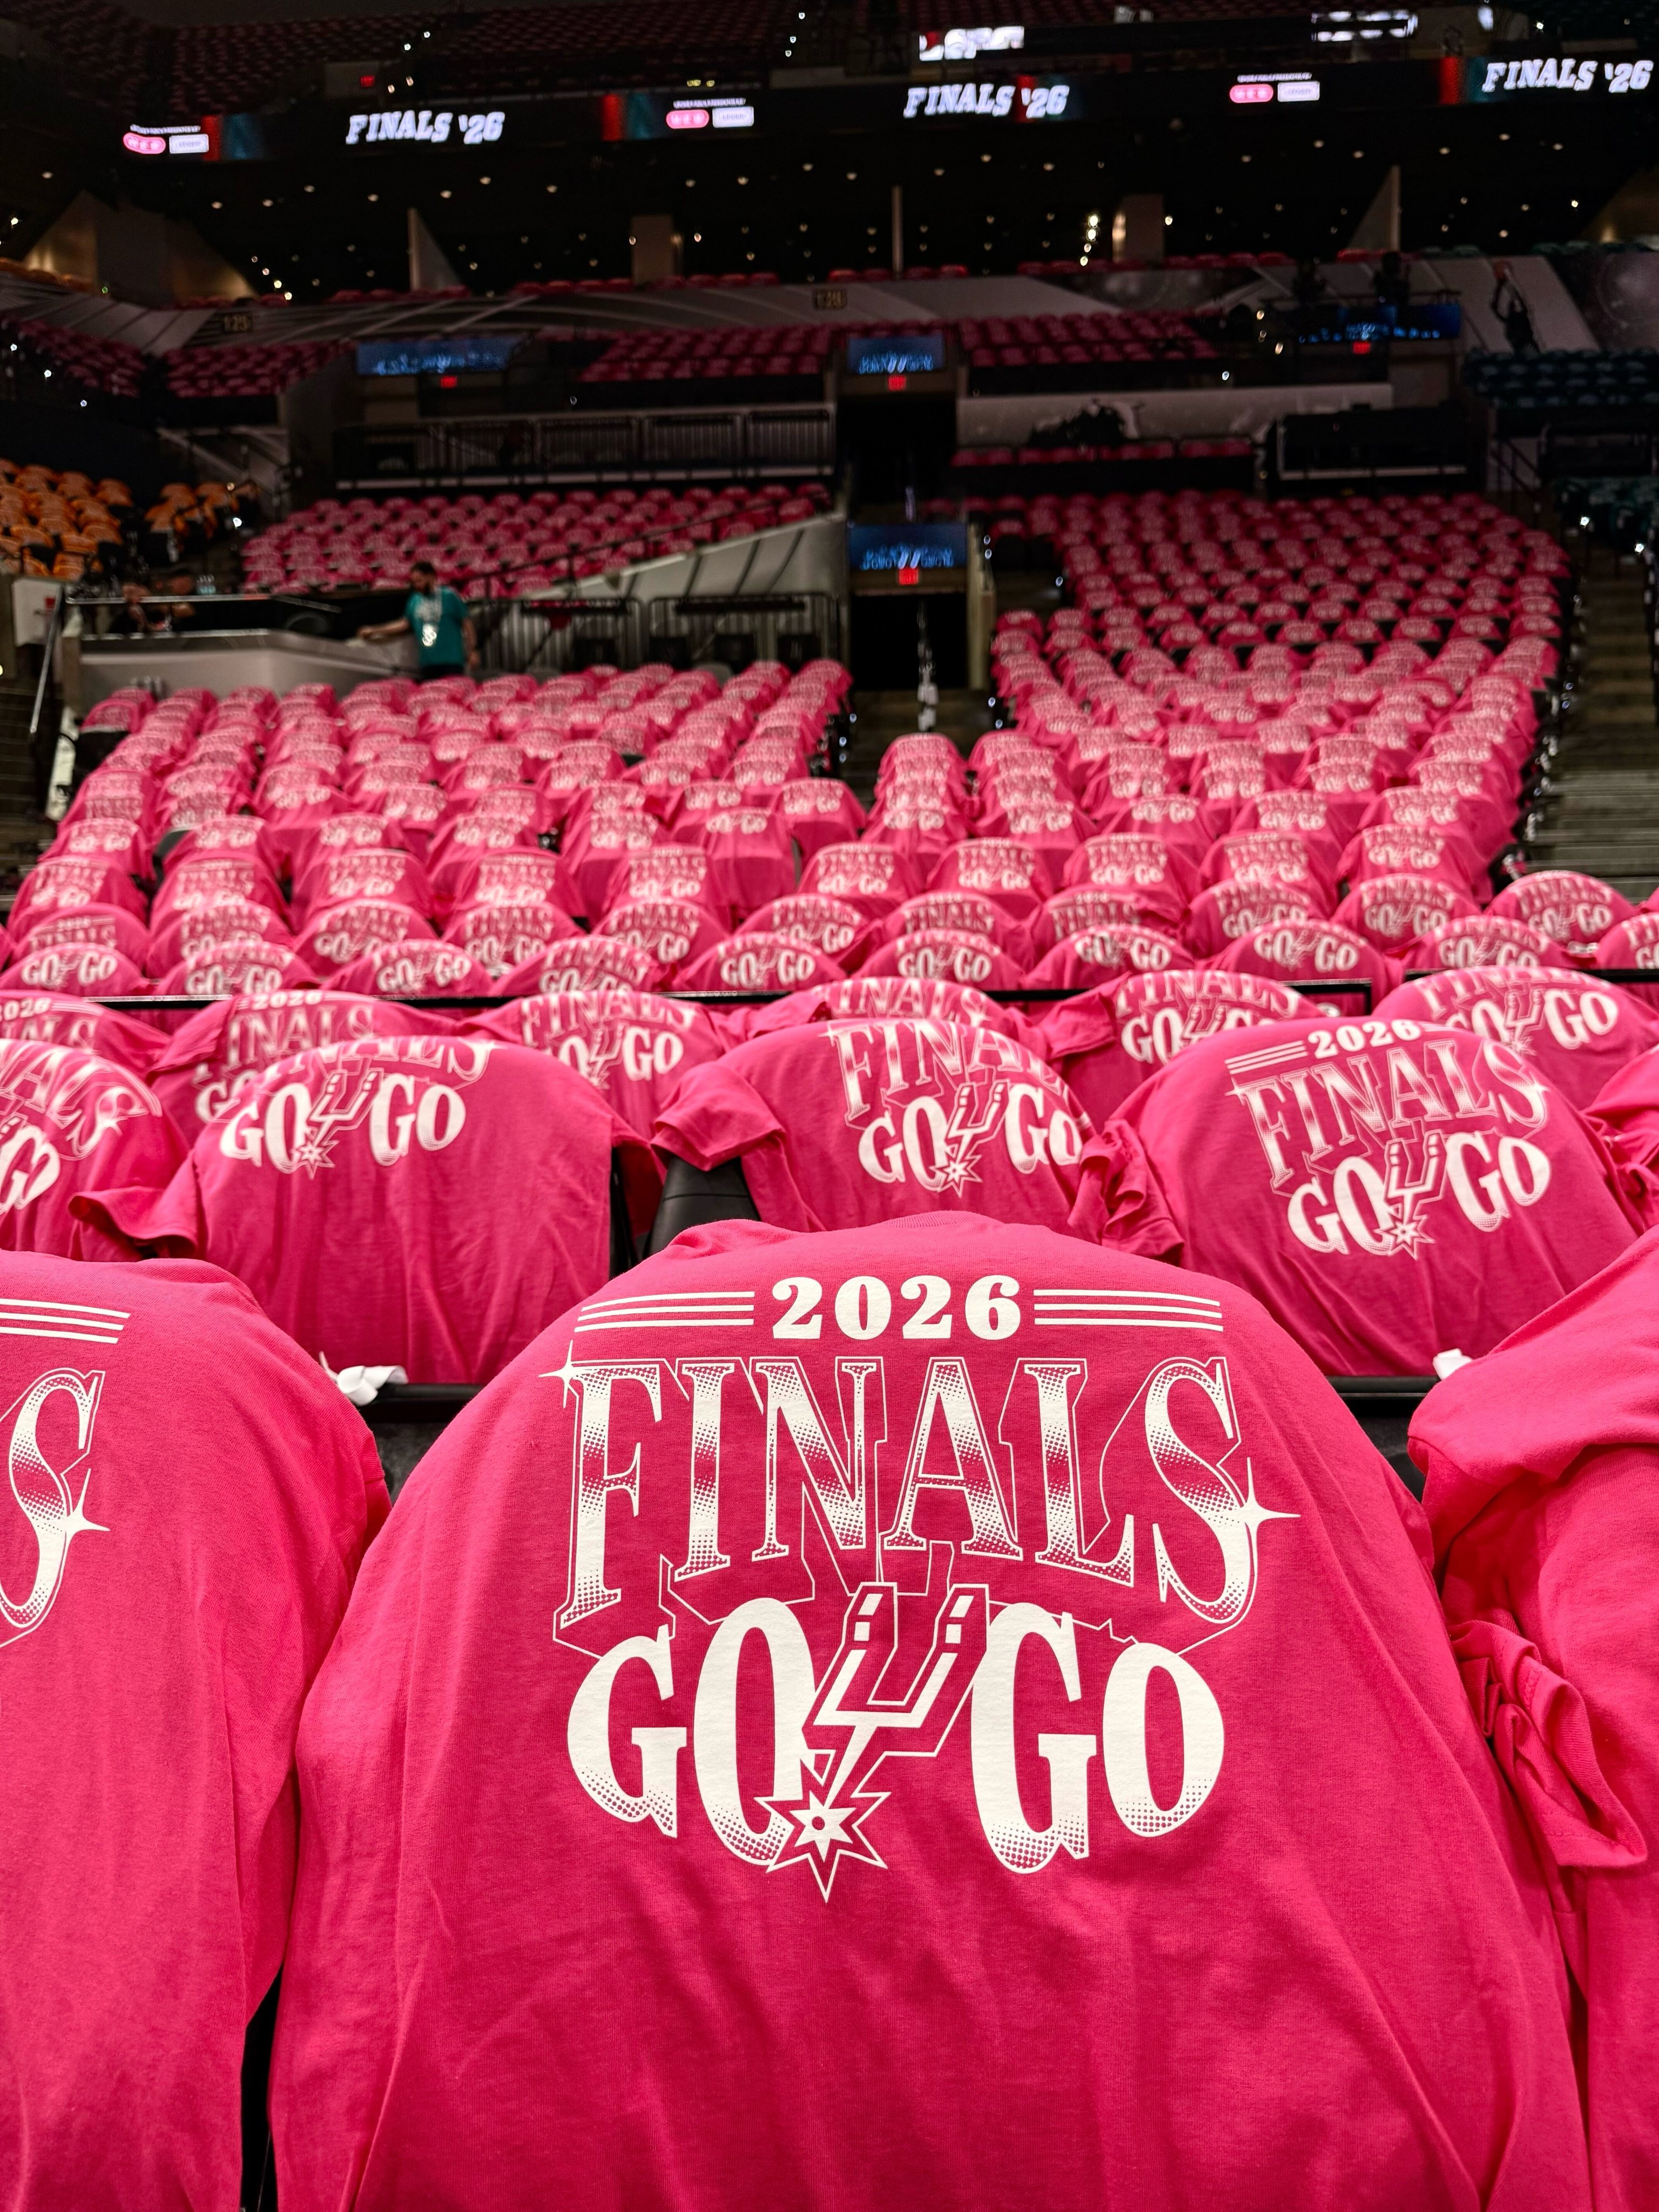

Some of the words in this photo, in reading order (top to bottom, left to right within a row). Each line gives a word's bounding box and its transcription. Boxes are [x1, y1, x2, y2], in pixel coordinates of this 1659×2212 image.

[1482, 58, 1597, 92] FINALS
[1604, 60, 1654, 93] '26
[903, 84, 1015, 118] FINALS
[1022, 85, 1070, 118] '26
[346, 111, 453, 144] FINALS
[459, 111, 505, 144] '26
[22, 951, 60, 990] GO
[76, 950, 117, 985] GO
[377, 957, 416, 993] GO
[433, 952, 472, 988] GO
[720, 952, 760, 989] GO
[777, 950, 816, 986] GO
[898, 947, 935, 982] GO
[953, 946, 992, 983] GO
[1254, 929, 1297, 966] GO
[1314, 936, 1359, 973] GO
[0, 997, 52, 1022] 026
[1543, 988, 1618, 1050] GO
[622, 1026, 683, 1081] GO
[1121, 1007, 1185, 1066] GO
[1308, 1020, 1423, 1059] 2026
[220, 1082, 312, 1174] GO
[369, 1073, 467, 1167] GO
[858, 1096, 948, 1192] GO
[1004, 1083, 1082, 1174] GO
[1240, 1038, 1550, 1191] FINALS
[1287, 1155, 1393, 1256] GO
[1445, 1131, 1551, 1232] GO
[772, 1275, 1022, 1340] 2026
[555, 1356, 1258, 1626] FINALS
[567, 1597, 817, 1865] GO
[971, 1602, 1225, 1874] GO
